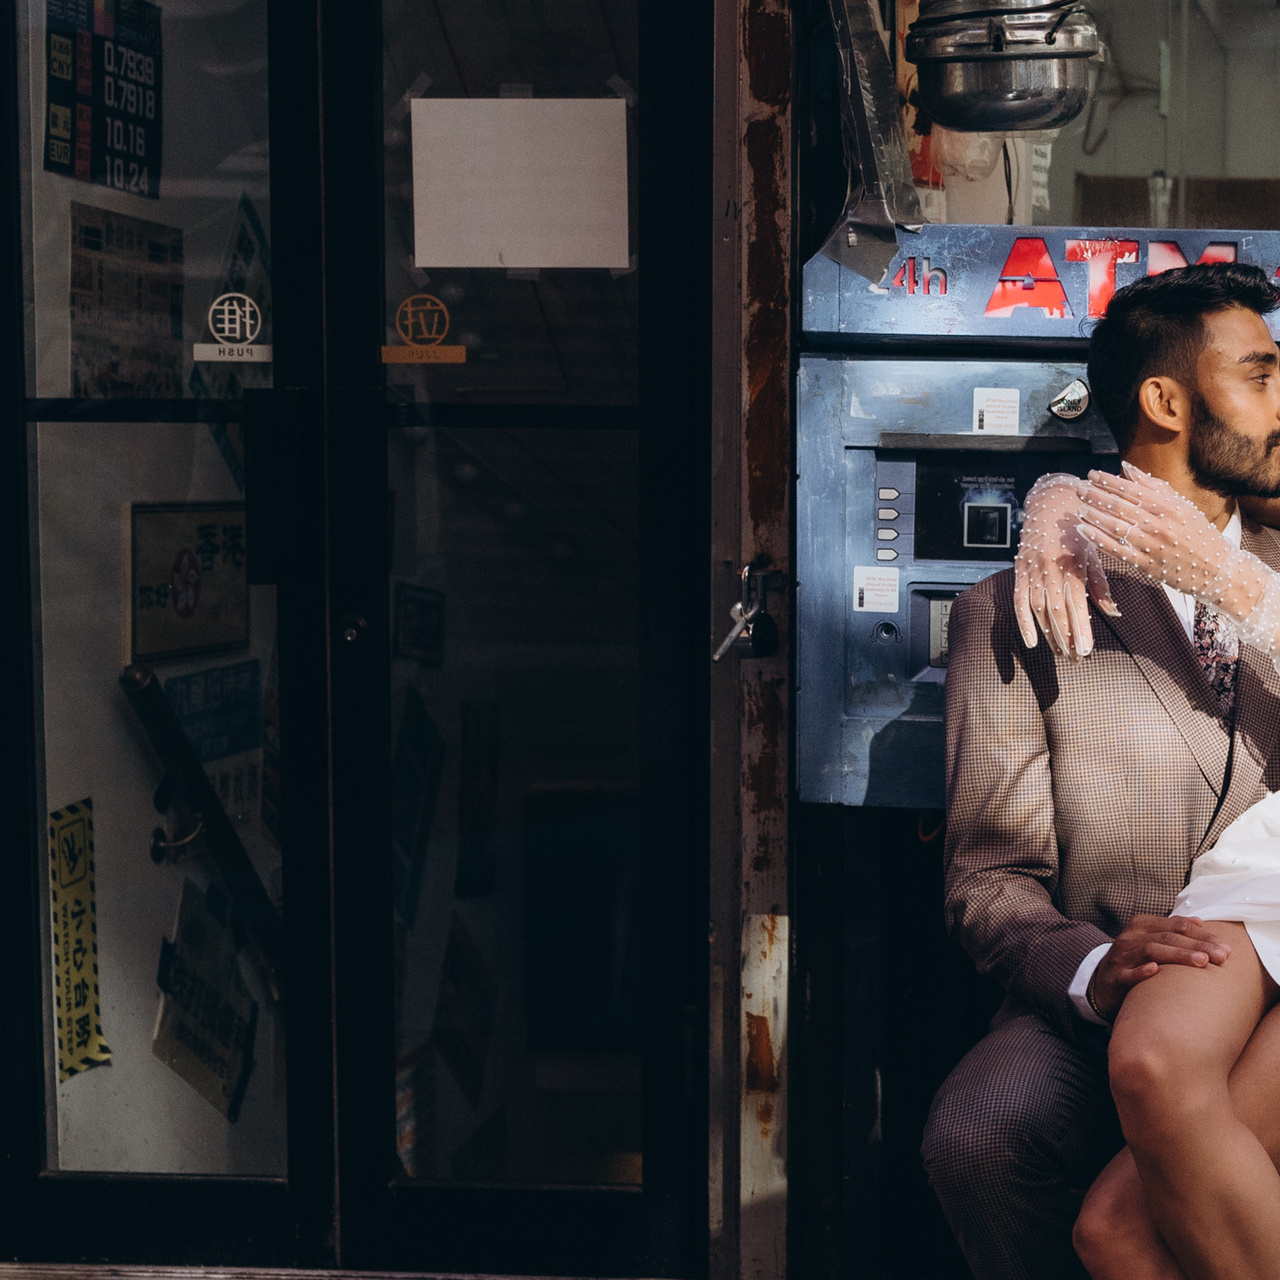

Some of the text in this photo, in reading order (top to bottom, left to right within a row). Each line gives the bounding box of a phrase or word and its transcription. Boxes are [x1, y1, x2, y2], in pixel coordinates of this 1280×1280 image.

[50, 57, 72, 79] CNY
[103, 75, 156, 120] 0.7918
[49, 141, 71, 162] EUR
[104, 154, 149, 196] 10.24
[869, 257, 948, 295] 4h
[403, 297, 443, 341] 拉
[1057, 405, 1082, 413] ISLAND
[60, 901, 75, 1058] WATCH YOUR STEP
